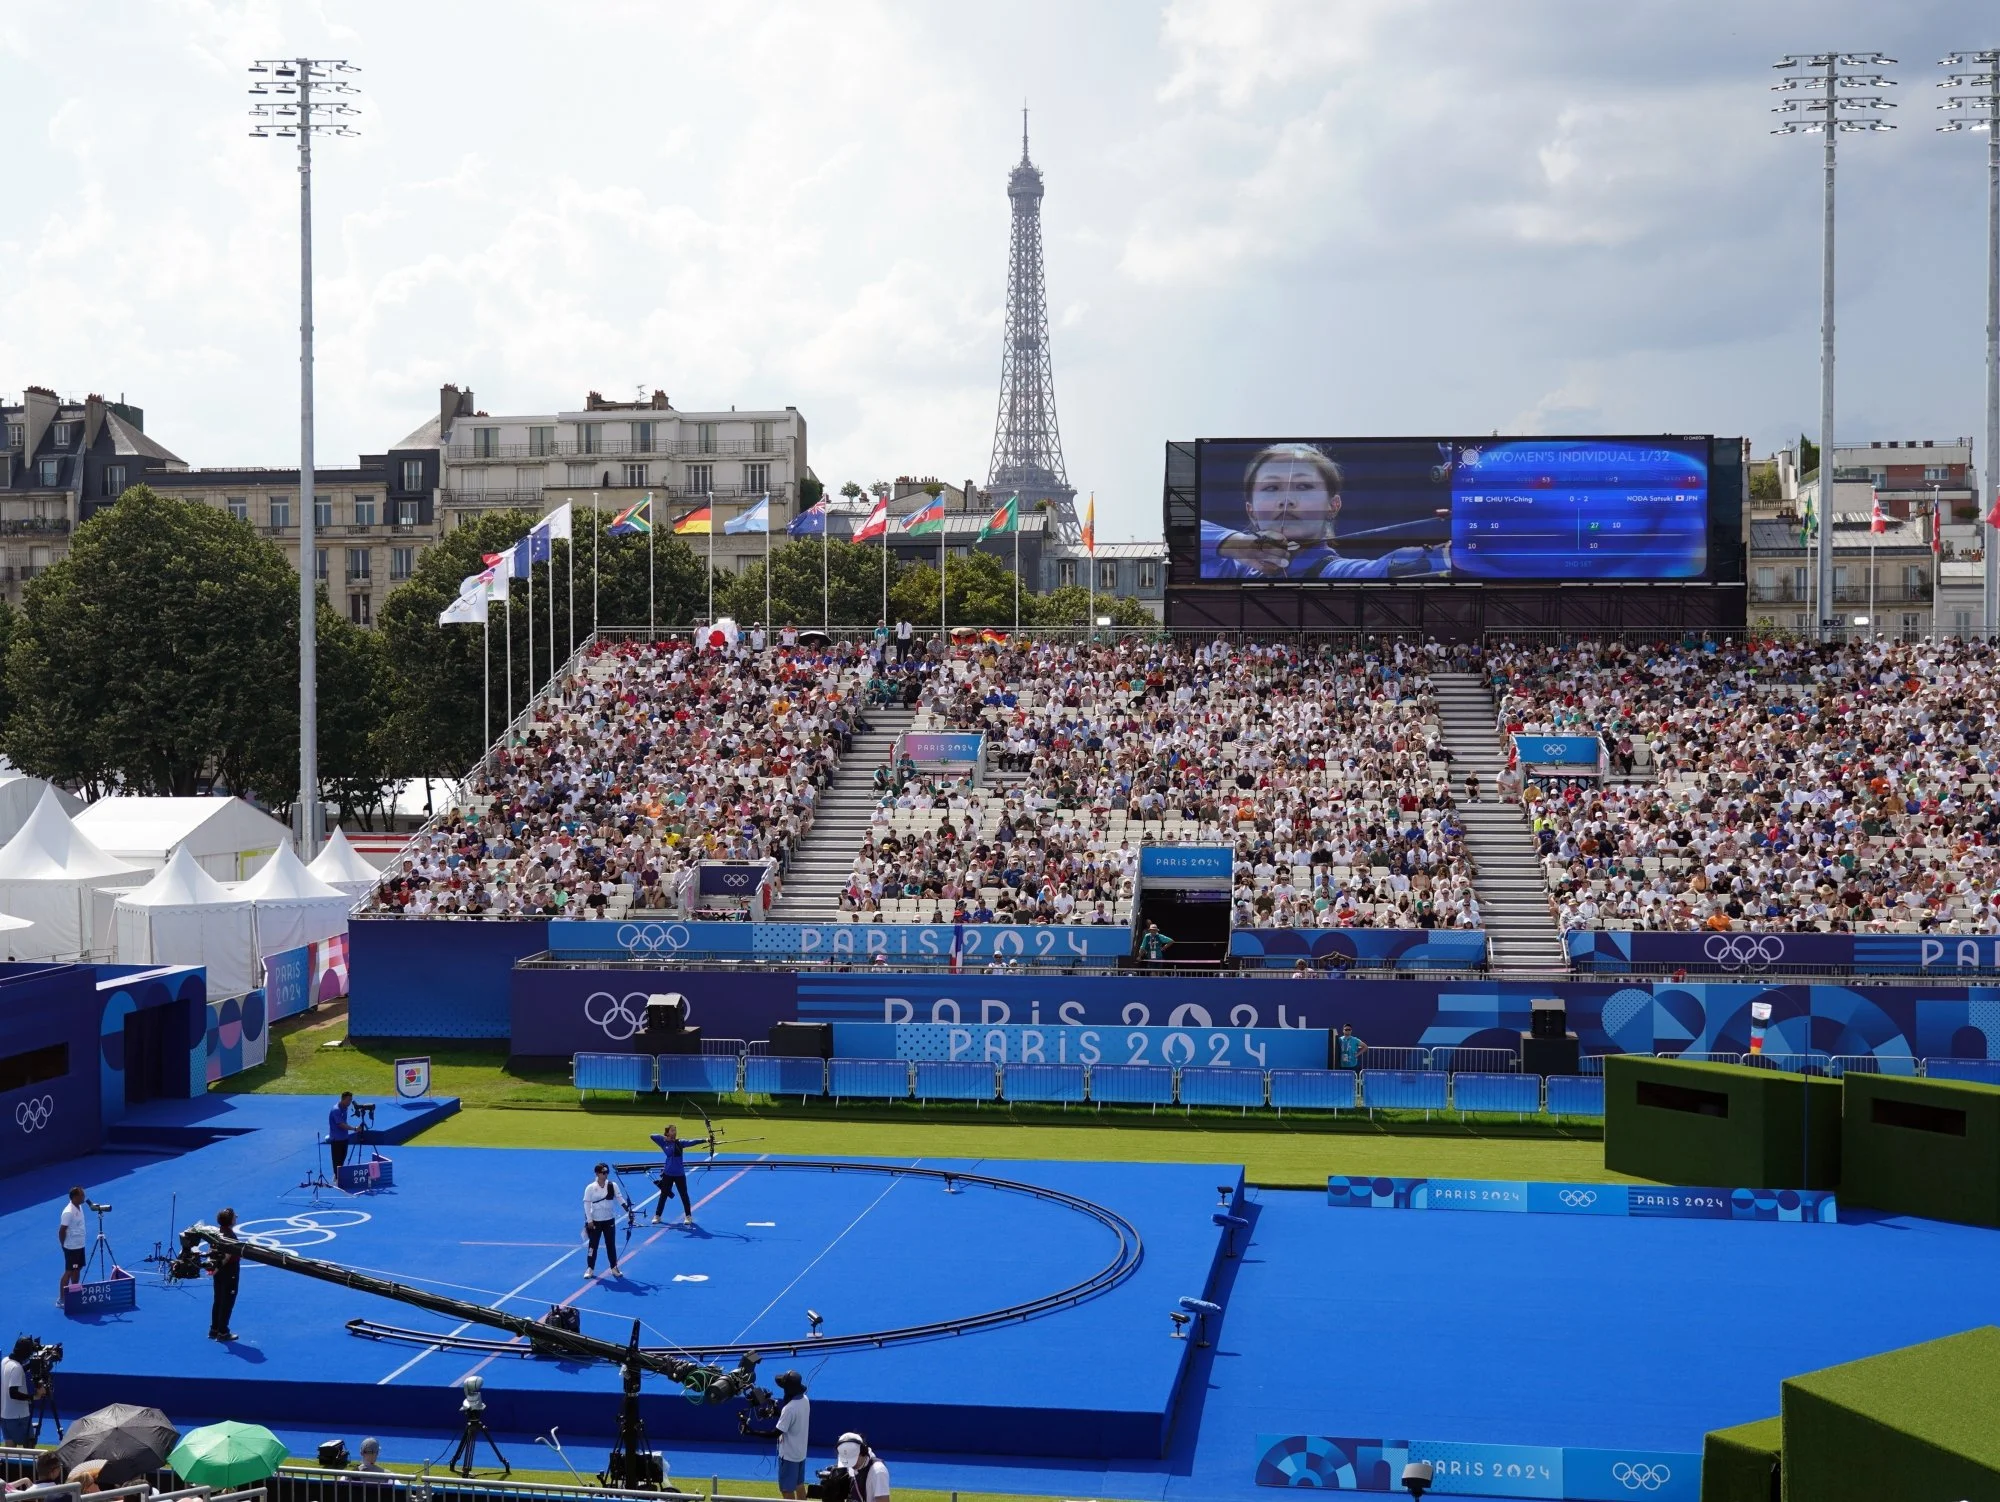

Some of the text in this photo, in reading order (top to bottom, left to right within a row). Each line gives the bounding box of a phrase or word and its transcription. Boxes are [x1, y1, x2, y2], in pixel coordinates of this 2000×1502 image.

[1490, 450, 1670, 463] WOMEN'S INDIVIDUAL 1/32
[1504, 496, 1533, 504] Yi-Ching
[947, 744, 973, 752] 2024
[1191, 858, 1220, 866] 2024
[962, 929, 1088, 961] 2024
[1921, 939, 2000, 972] PA
[276, 984, 301, 1004] 2024
[1126, 1031, 1266, 1067] 2024
[1482, 1190, 1520, 1201] 2024
[1685, 1197, 1724, 1208] 2024
[81, 1293, 111, 1304] 2024
[1492, 1463, 1550, 1480] 2024
